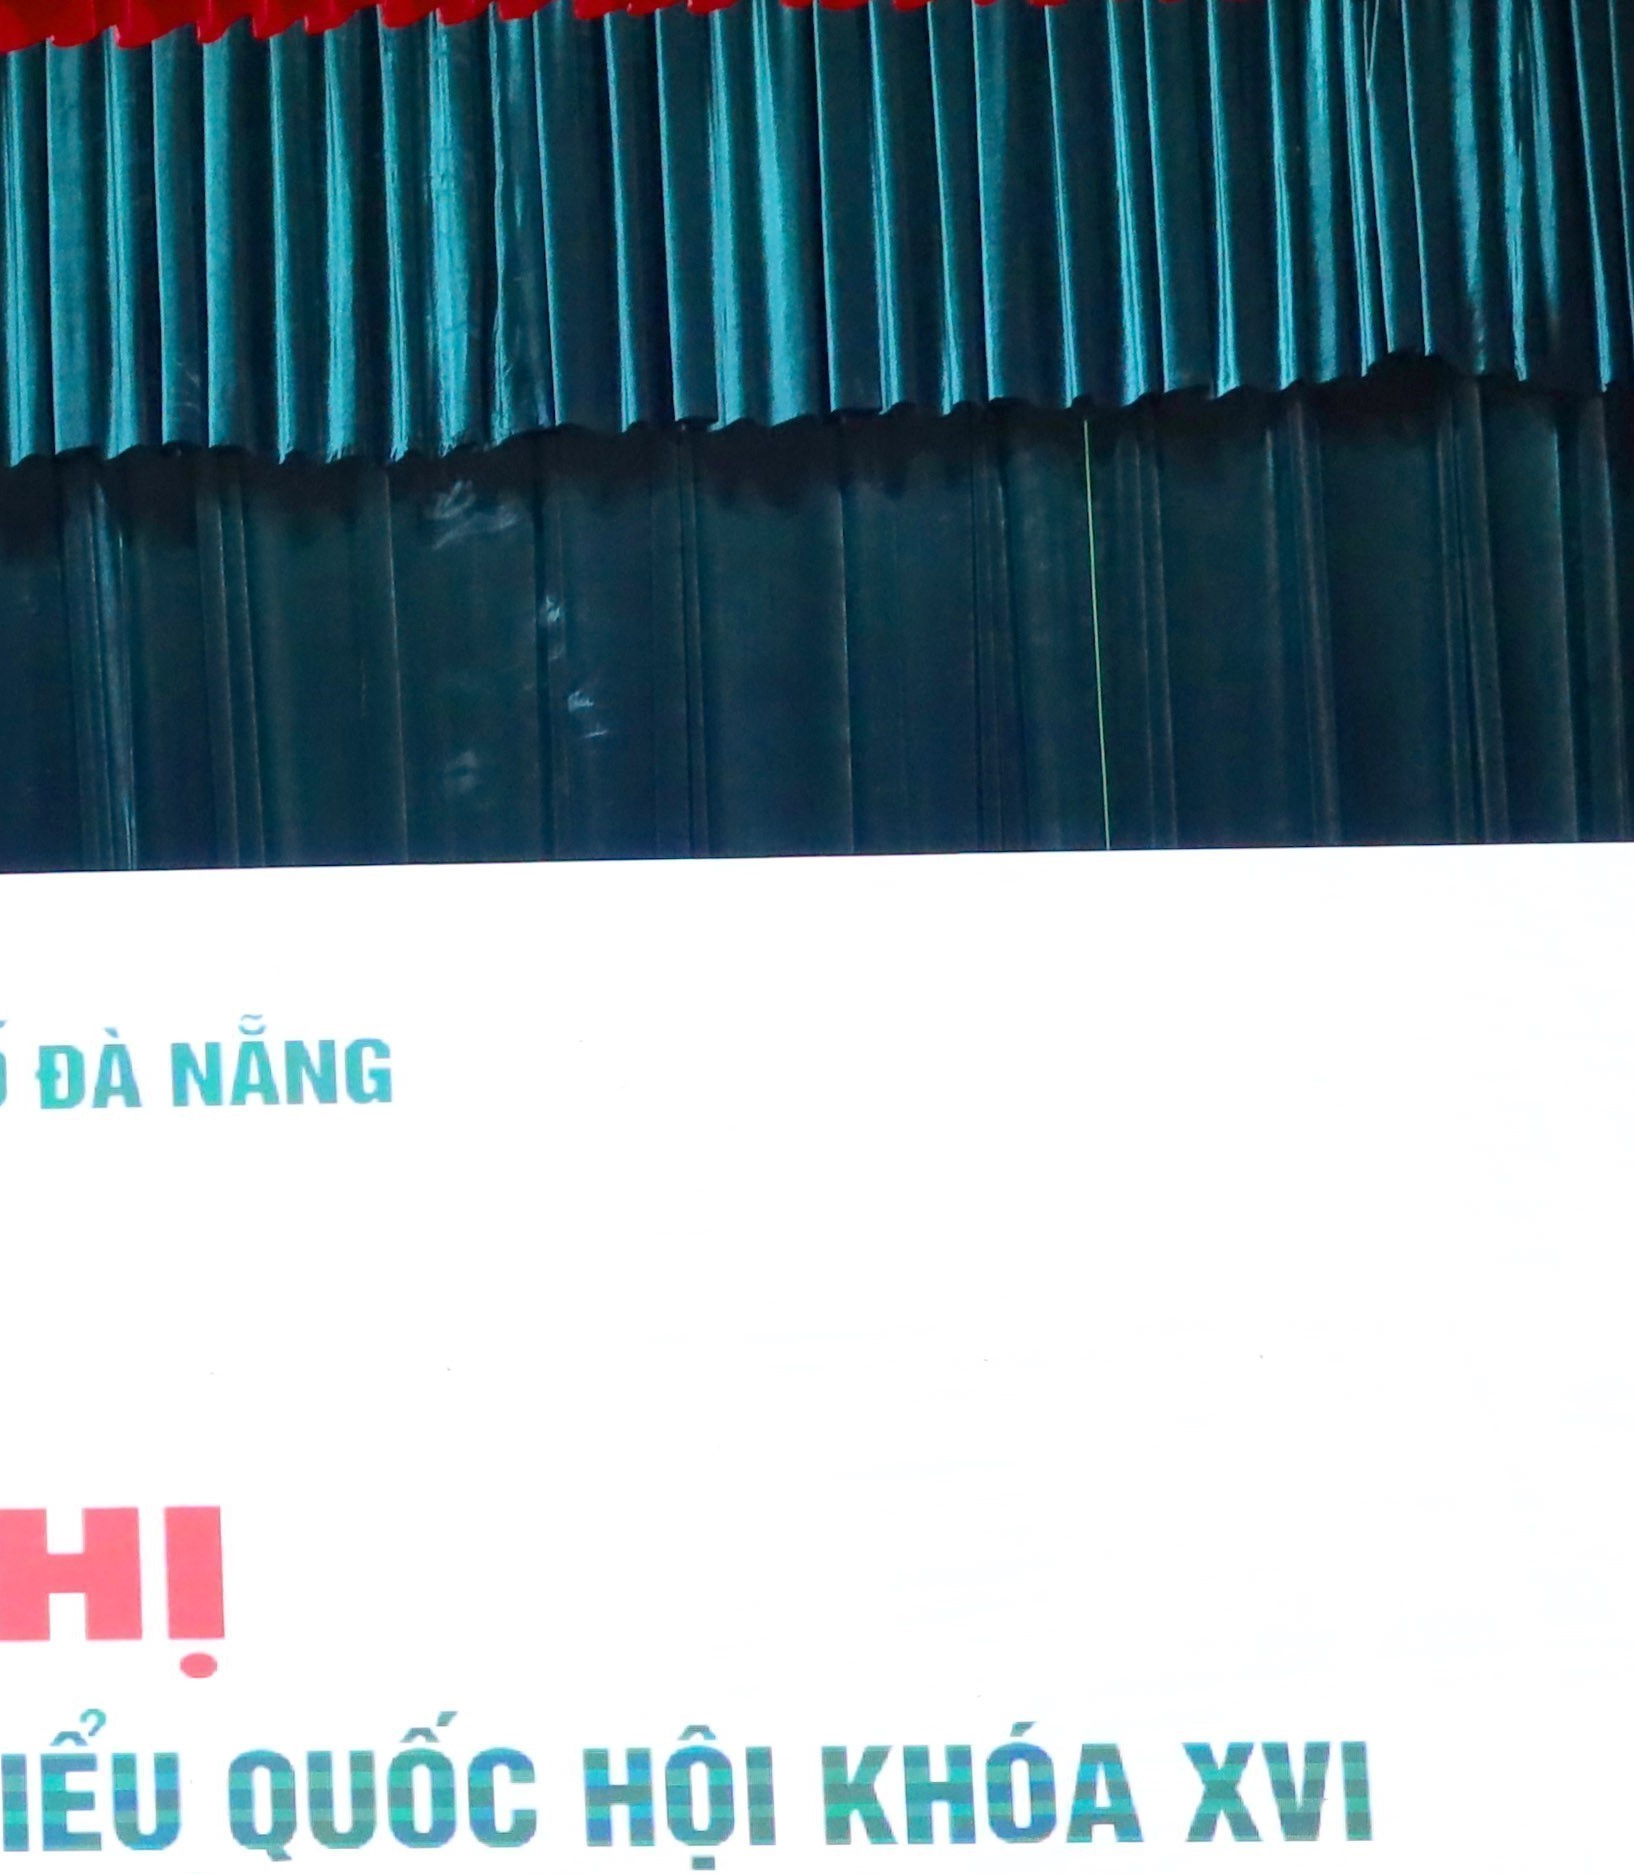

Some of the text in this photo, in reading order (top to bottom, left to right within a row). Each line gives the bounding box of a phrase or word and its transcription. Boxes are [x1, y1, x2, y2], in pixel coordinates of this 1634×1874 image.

[35, 1028, 142, 1110] ĐÀ
[171, 1015, 392, 1107] NẴNG
[228, 1711, 537, 1862] QUỐC
[583, 1725, 776, 1870] HỘI
[821, 1721, 1144, 1845] KHÓA
[1182, 1741, 1372, 1842] XVI
